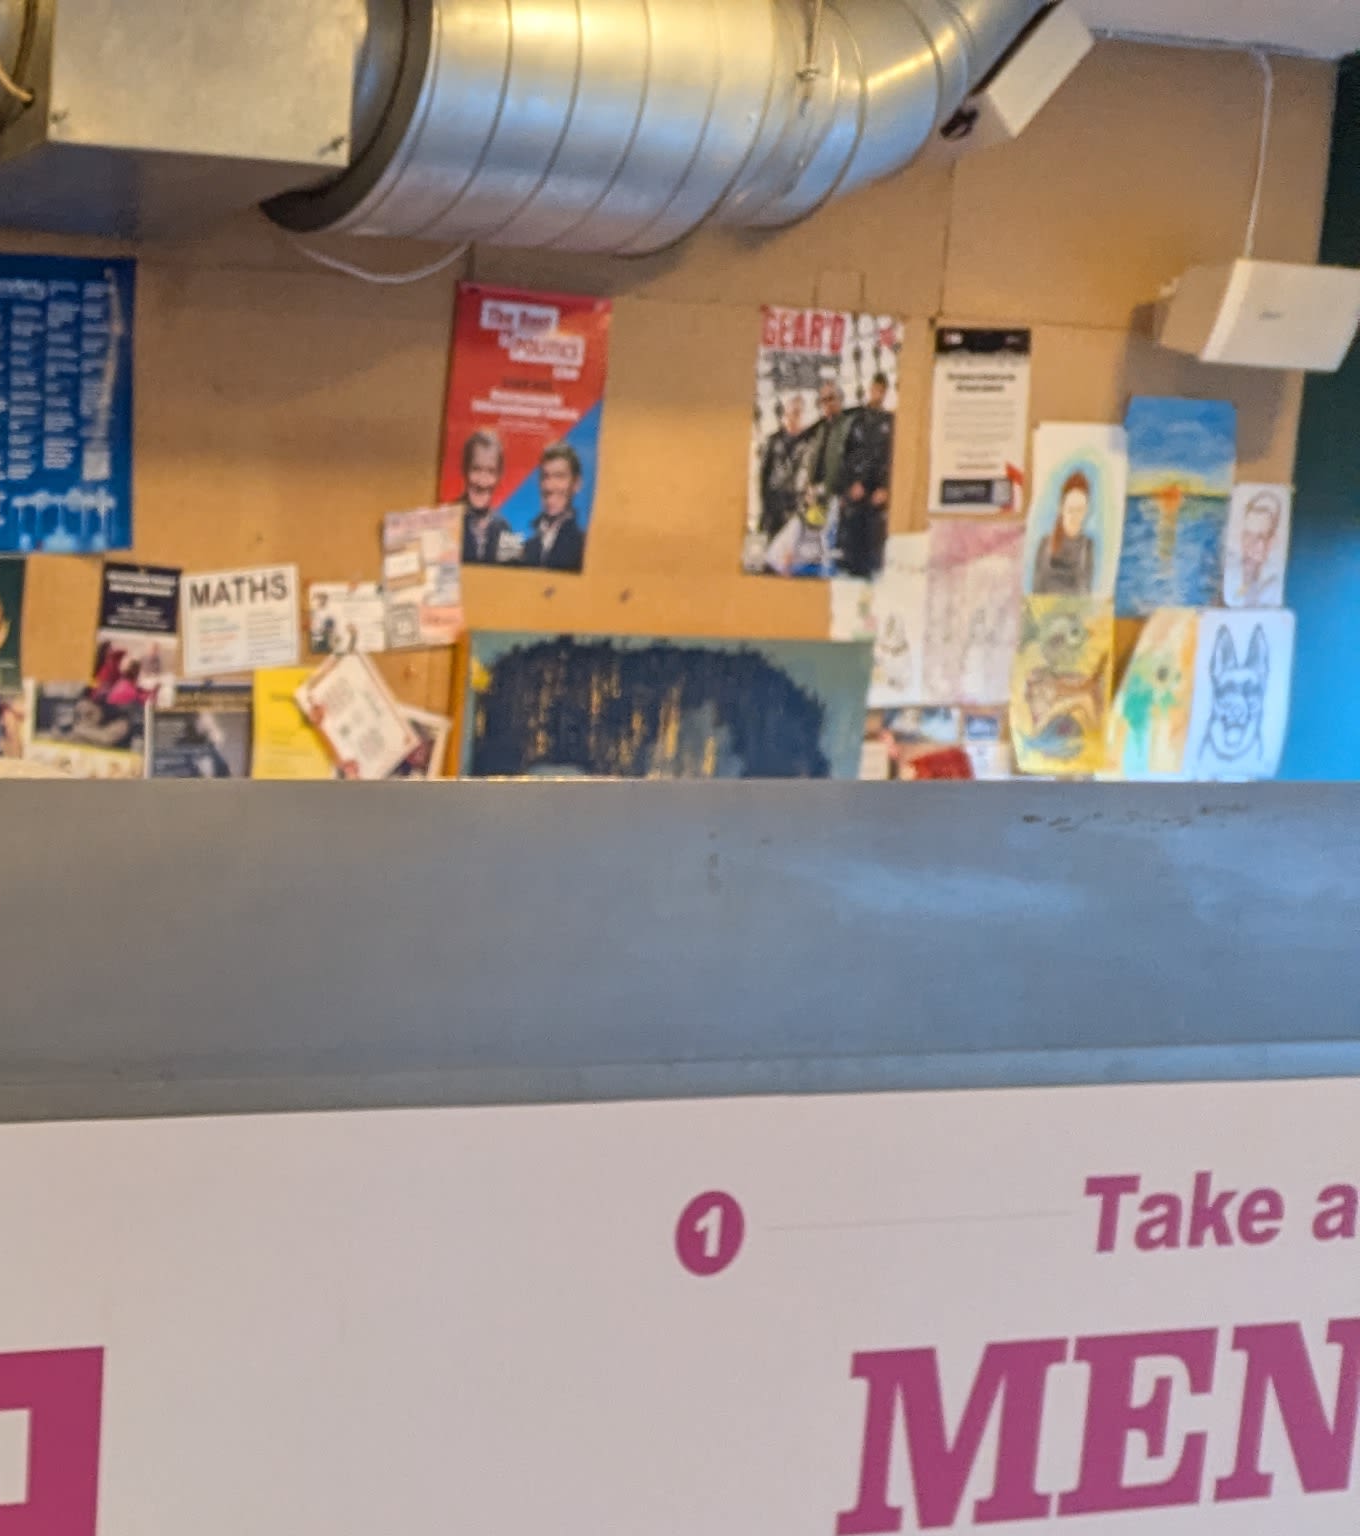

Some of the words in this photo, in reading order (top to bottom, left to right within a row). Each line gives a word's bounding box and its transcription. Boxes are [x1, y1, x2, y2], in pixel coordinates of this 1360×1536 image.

[189, 573, 289, 608] MATHS
[1085, 1171, 1284, 1251] Take
[1313, 1185, 1357, 1240] a
